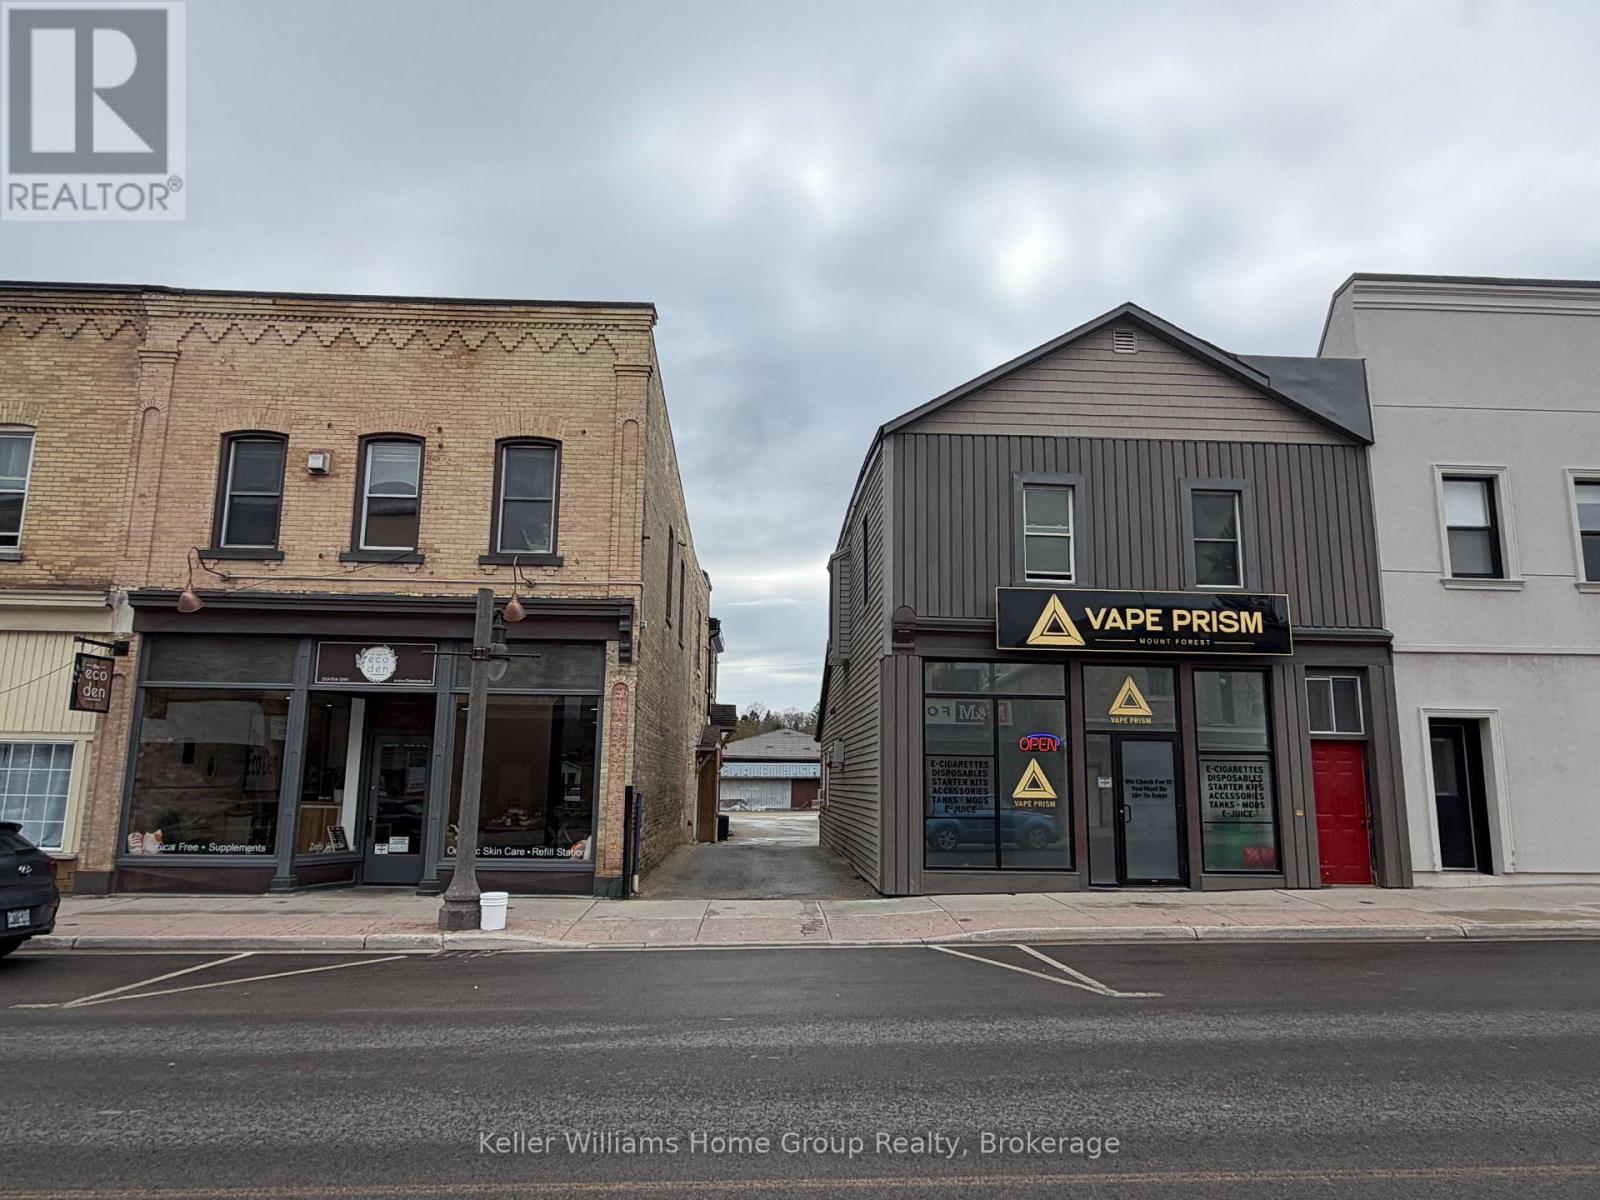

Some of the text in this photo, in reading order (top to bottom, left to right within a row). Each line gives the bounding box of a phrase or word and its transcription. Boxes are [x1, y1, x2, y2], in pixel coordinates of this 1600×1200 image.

[1085, 607, 1263, 634] VAPE PRISM
[368, 656, 389, 664] eco
[367, 665, 389, 673] den
[85, 669, 107, 681] eco
[83, 681, 106, 699] den
[1110, 716, 1152, 724] VAPE PRISM
[1019, 737, 1057, 752] OPEN
[930, 760, 989, 769] E-CIGARETTES
[931, 769, 988, 777] DISPOSABLES
[1206, 765, 1263, 774] E-CIGARETTES
[931, 778, 968, 786] STARTER
[1207, 774, 1263, 782] DISPOSABLES
[931, 787, 988, 795] ACCESSORIES
[1208, 783, 1264, 792] STARTER KITS
[932, 796, 989, 804] TANKS MODS
[1208, 792, 1264, 800] ACCESSORIES
[1014, 800, 1056, 808] VAPE PRISM
[1209, 801, 1265, 809] TANKS MODS
[944, 805, 976, 813] E-JUICE
[1221, 810, 1253, 818] E-JUICE
[178, 843, 199, 852] Free
[208, 842, 266, 854] Supplements
[483, 846, 502, 855] Skin
[504, 847, 525, 856] Care
[532, 847, 554, 856] Refill
